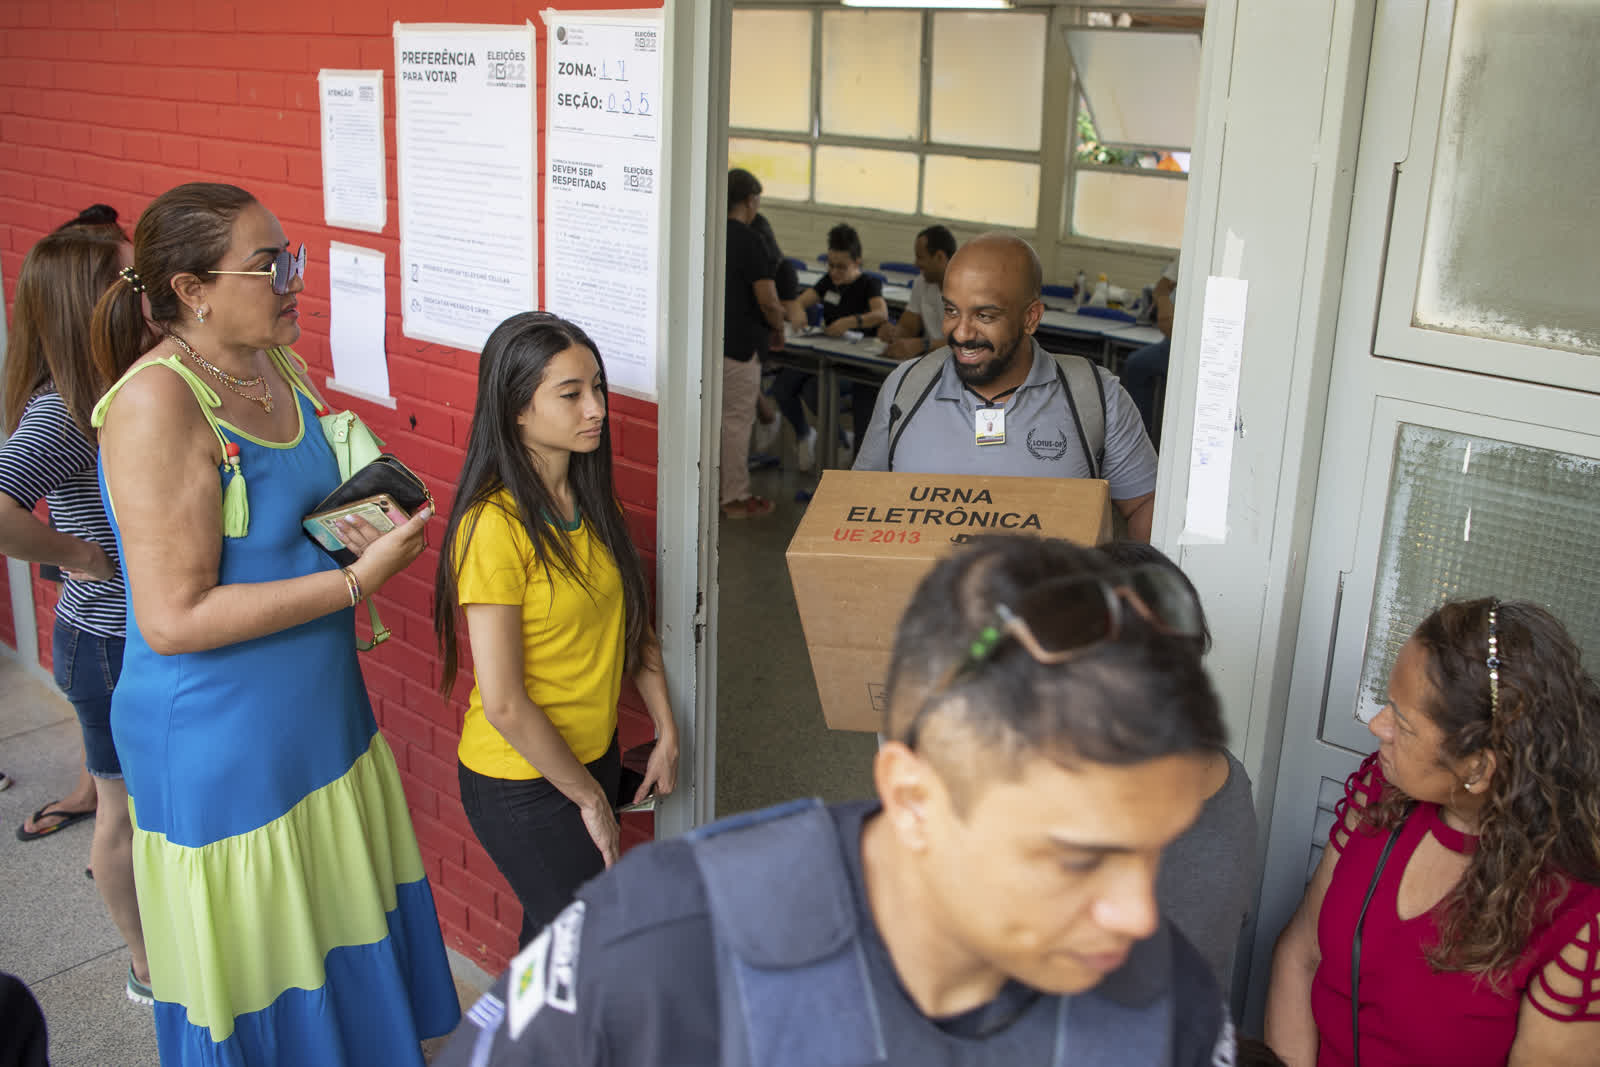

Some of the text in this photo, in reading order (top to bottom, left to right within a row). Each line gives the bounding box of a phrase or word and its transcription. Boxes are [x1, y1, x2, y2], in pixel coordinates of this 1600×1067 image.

[402, 49, 476, 66] PREFERÊNCIA
[487, 50, 526, 62] ELEIÇÕES
[402, 70, 457, 82] PARA VOTAR
[558, 62, 597, 77] ZONA:
[557, 92, 602, 110] SEÇÃO:
[552, 164, 594, 177] DEVEM SER
[623, 166, 654, 176] ELEIÇÕES
[552, 175, 607, 191] RESPEITADAS
[909, 486, 993, 505] URNA
[847, 506, 1042, 530] ELETRÔNICA
[833, 528, 921, 544] UE 2013
